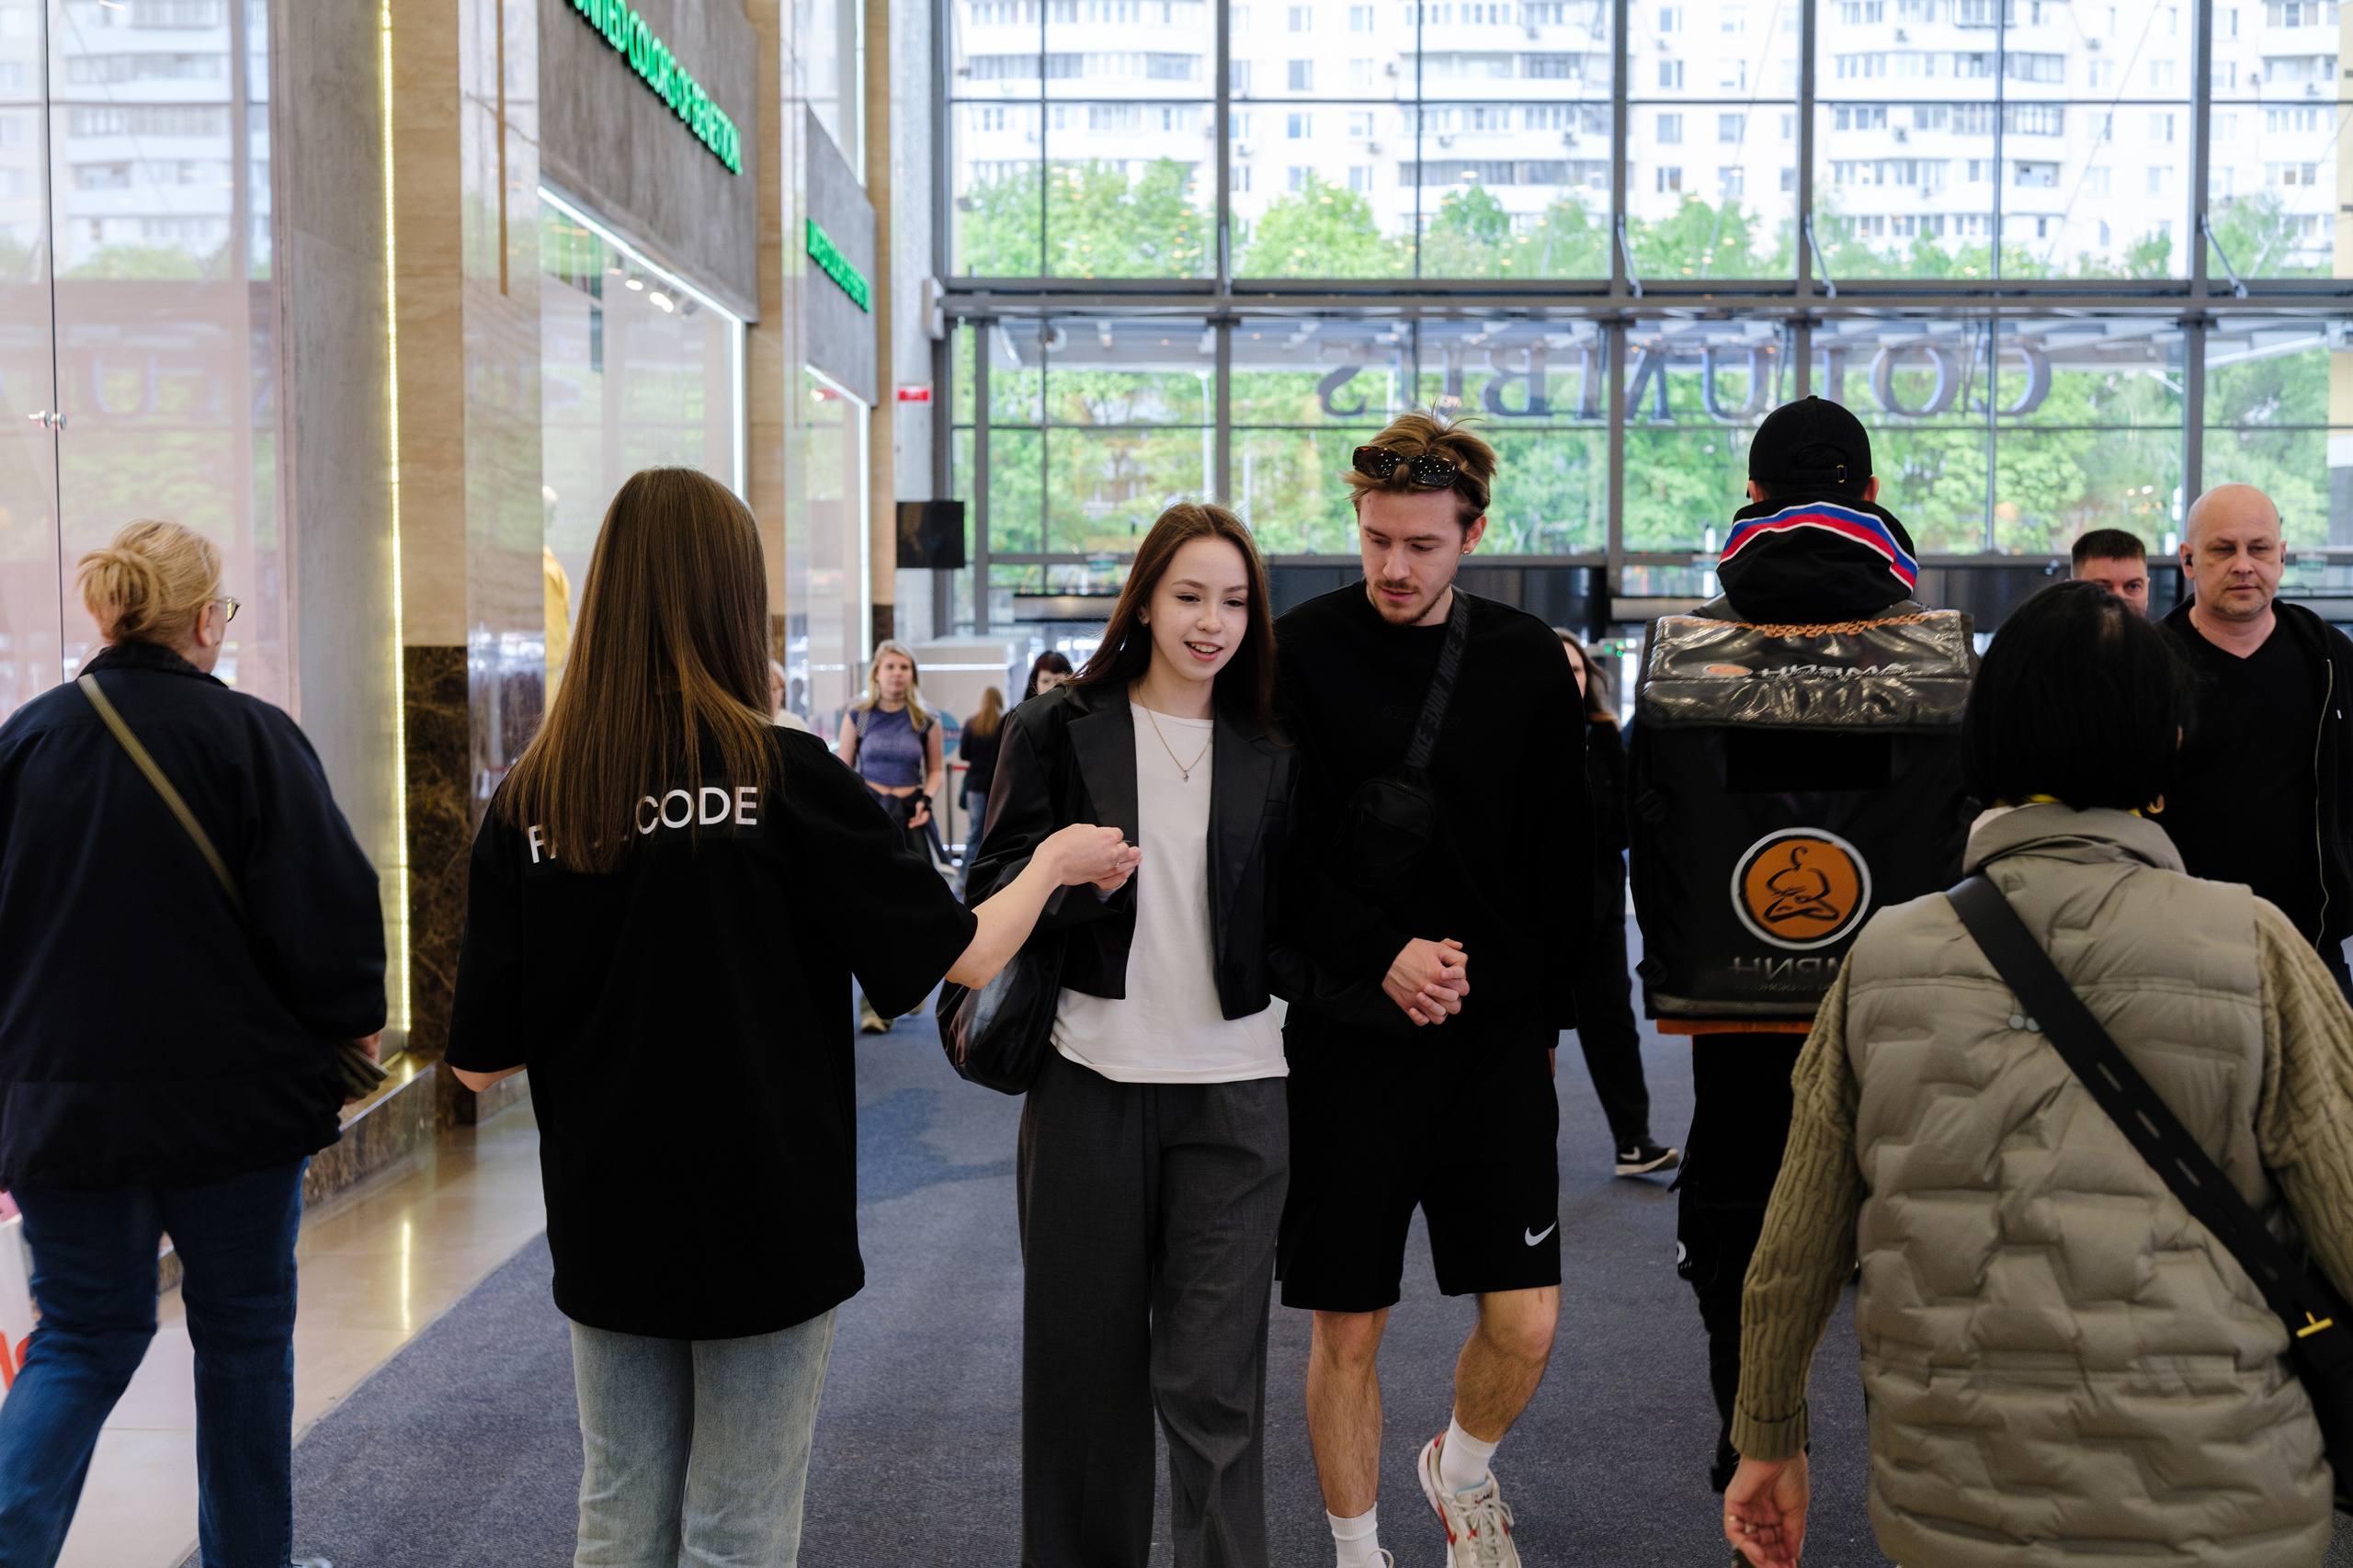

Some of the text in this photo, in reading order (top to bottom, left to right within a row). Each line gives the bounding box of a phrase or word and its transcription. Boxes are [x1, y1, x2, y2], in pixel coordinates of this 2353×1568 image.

[628, 10, 676, 108] COLORS
[676, 66, 693, 123] OF
[1438, 636, 1463, 684] NIKE
[1422, 681, 1449, 730] NIKE
[1404, 725, 1434, 768] NIKE
[635, 786, 758, 835] CODE
